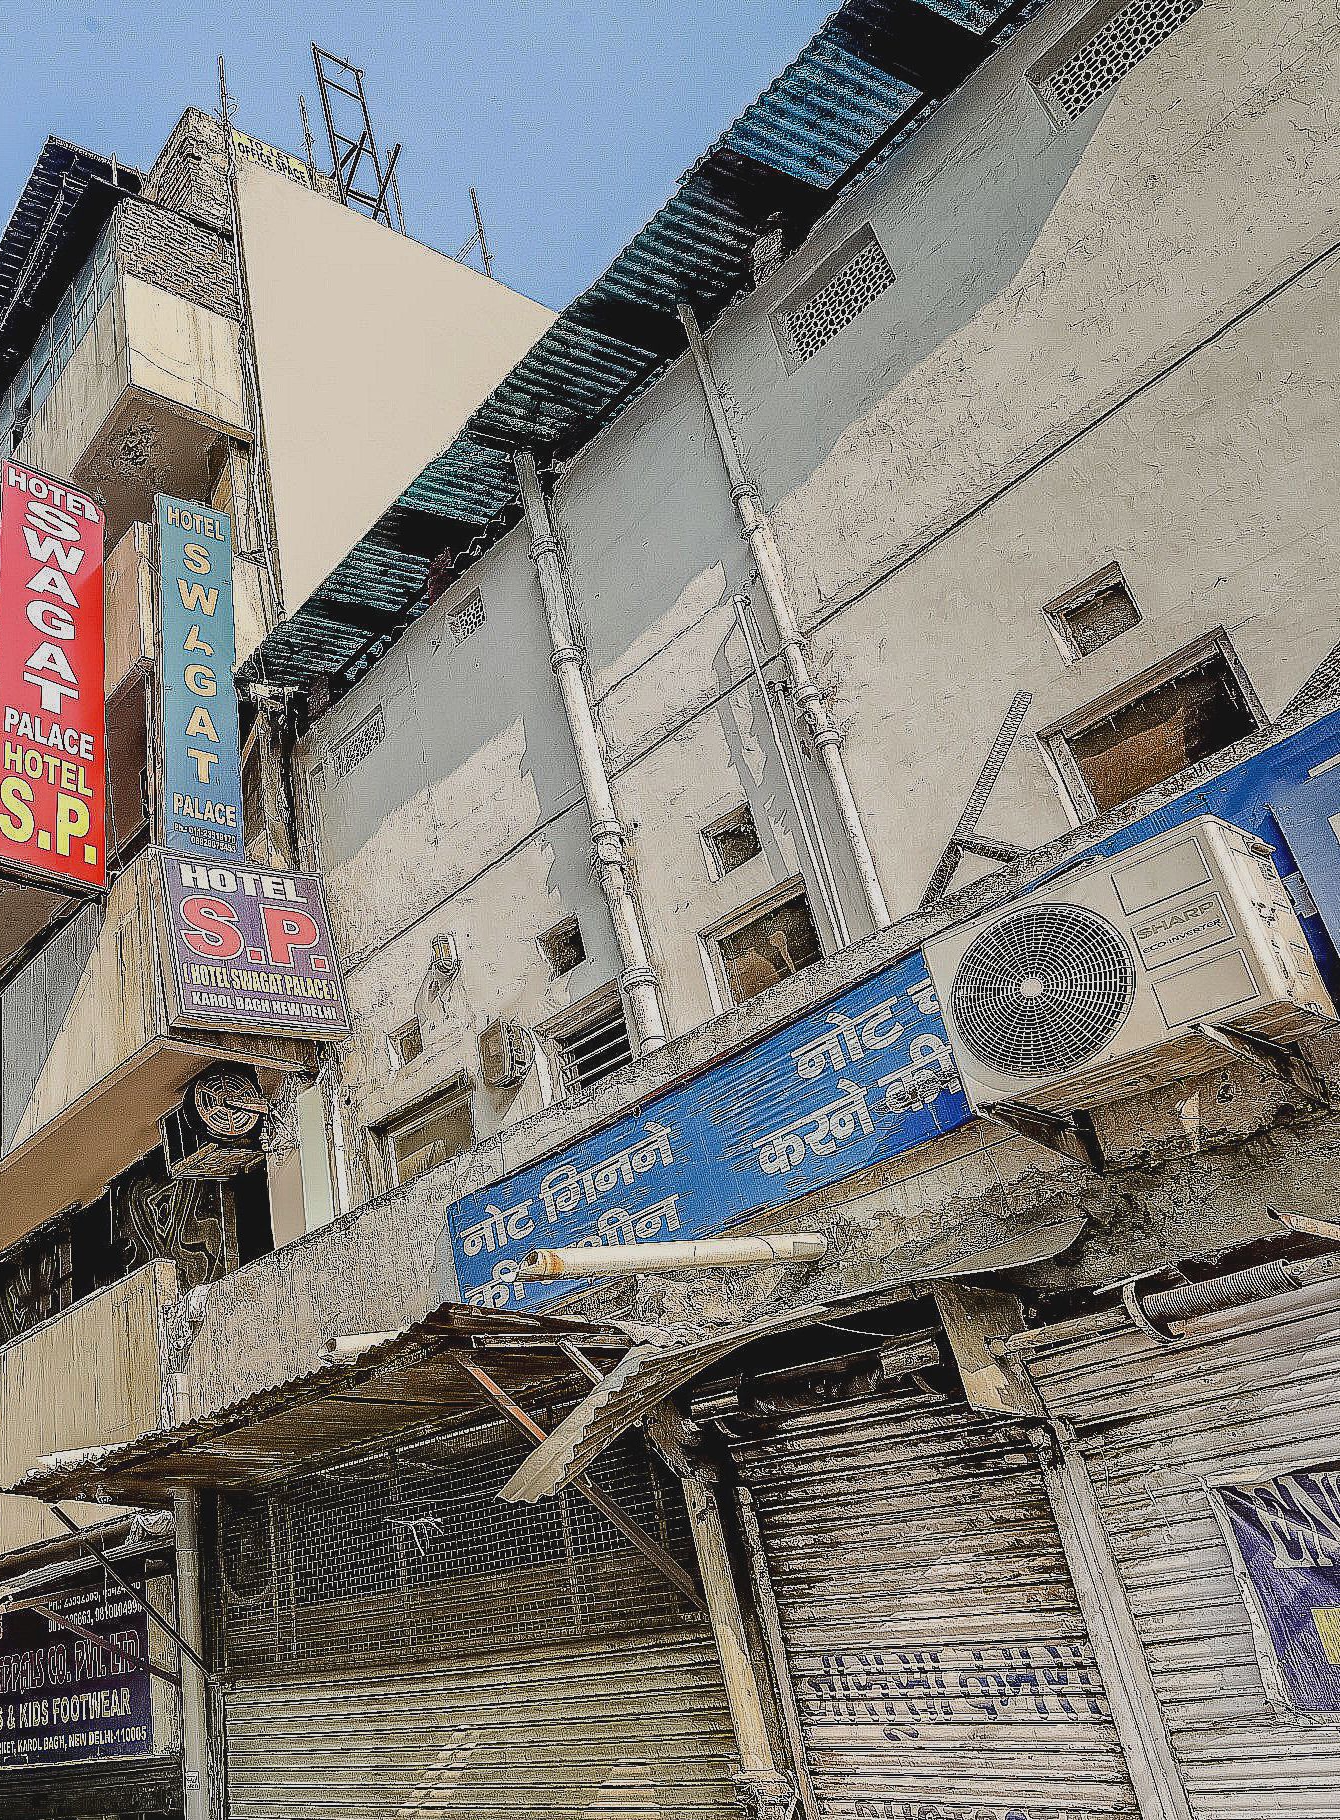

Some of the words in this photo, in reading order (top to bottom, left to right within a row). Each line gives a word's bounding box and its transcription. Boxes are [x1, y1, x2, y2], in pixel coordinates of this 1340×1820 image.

[7, 465, 101, 525] HOTEL
[166, 505, 227, 542] HOTEL
[21, 500, 86, 716] SWAGAT
[3, 705, 96, 761] PALACE
[3, 740, 94, 798] HOTEL
[173, 791, 238, 829] PALACE
[178, 863, 309, 905] HOTEL
[179, 894, 331, 974] S.P.
[1136, 901, 1215, 940] SHARP
[191, 990, 236, 1010] KAROL
[234, 995, 271, 1013] BAGH
[271, 1001, 301, 1018] NEW
[300, 1005, 338, 1021] DELHI
[230, 967, 284, 996] SWAGAT
[790, 995, 906, 1080] नोट
[752, 1076, 877, 1176] करने
[460, 1198, 537, 1258] नोट
[538, 1120, 675, 1224] गिनने
[6, 1704, 16, 1731] &
[19, 1699, 49, 1729] KIDS
[52, 1687, 132, 1724] FOOTWEAR
[17, 1737, 42, 1753] KAROL
[68, 1732, 87, 1748] NEW
